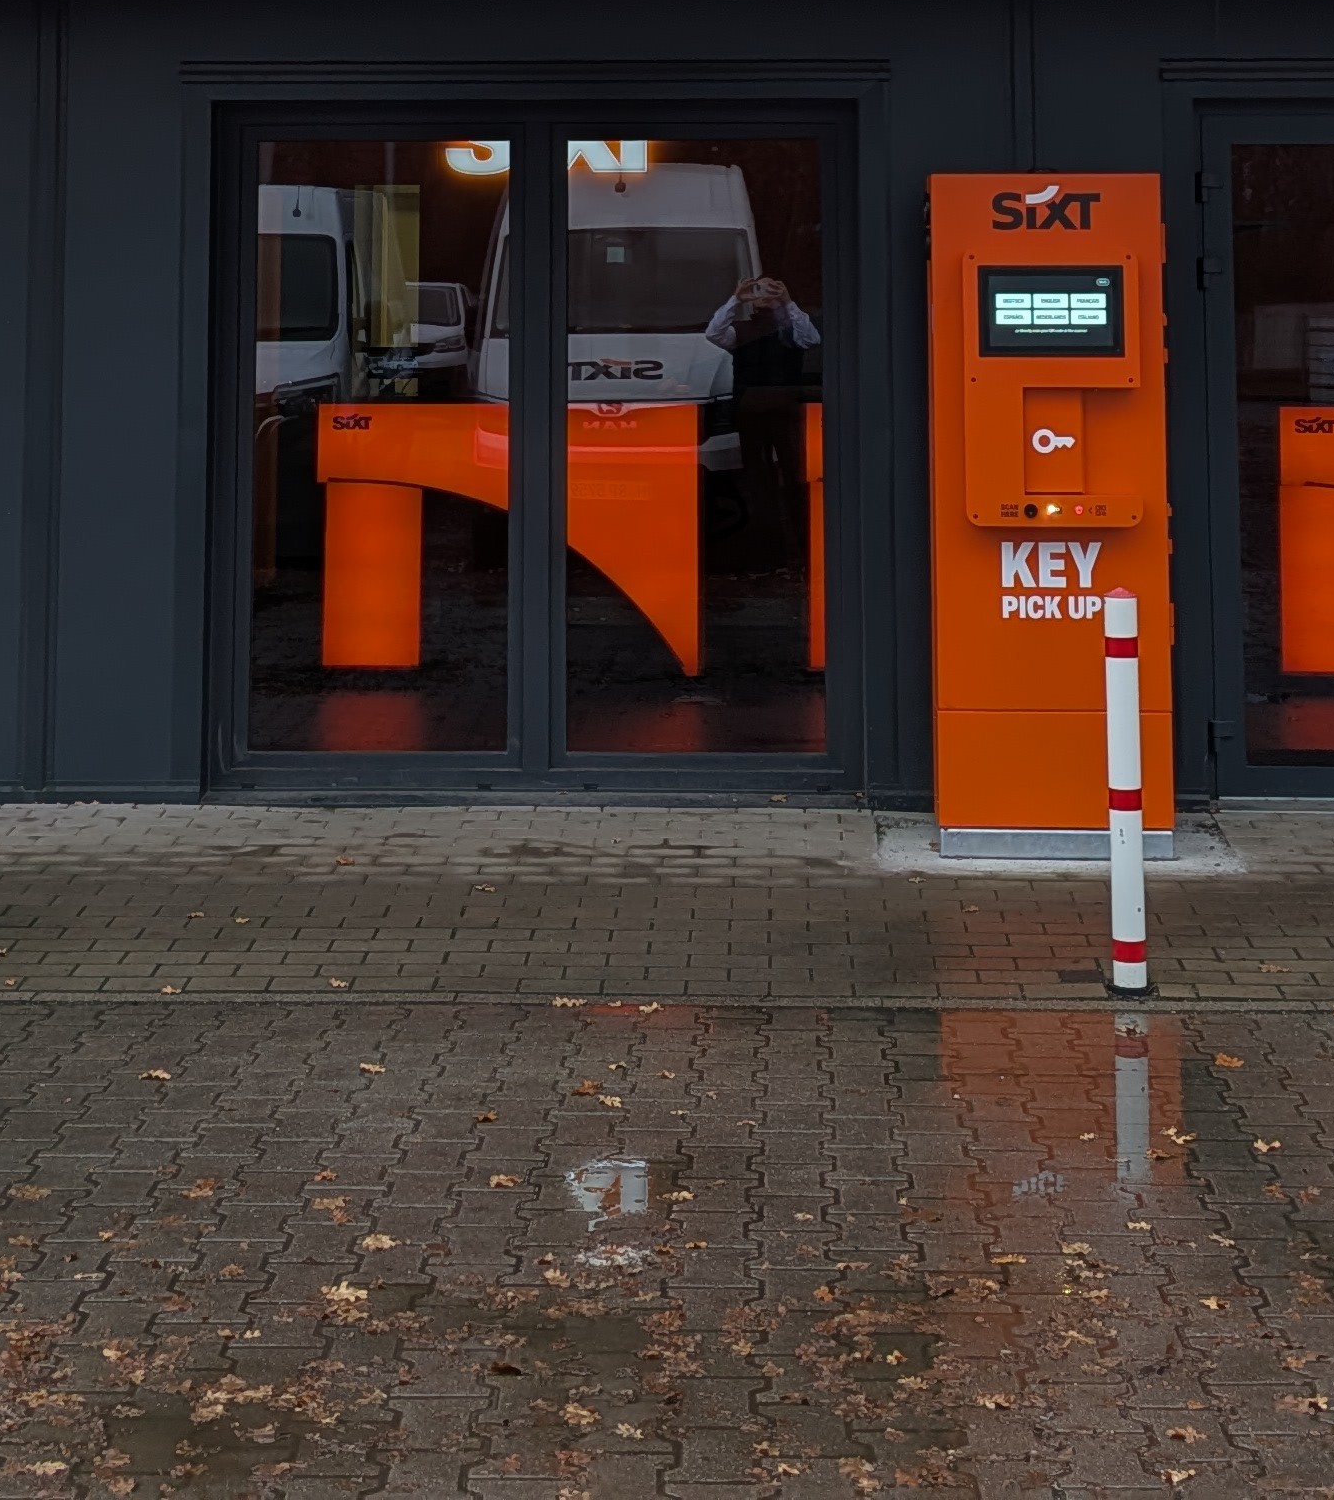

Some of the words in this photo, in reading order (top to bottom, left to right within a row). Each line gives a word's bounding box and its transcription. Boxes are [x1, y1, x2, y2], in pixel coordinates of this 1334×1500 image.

[1001, 541, 1102, 588] KEY
[1002, 595, 1063, 619] PICK
[1067, 595, 1102, 619] UP
